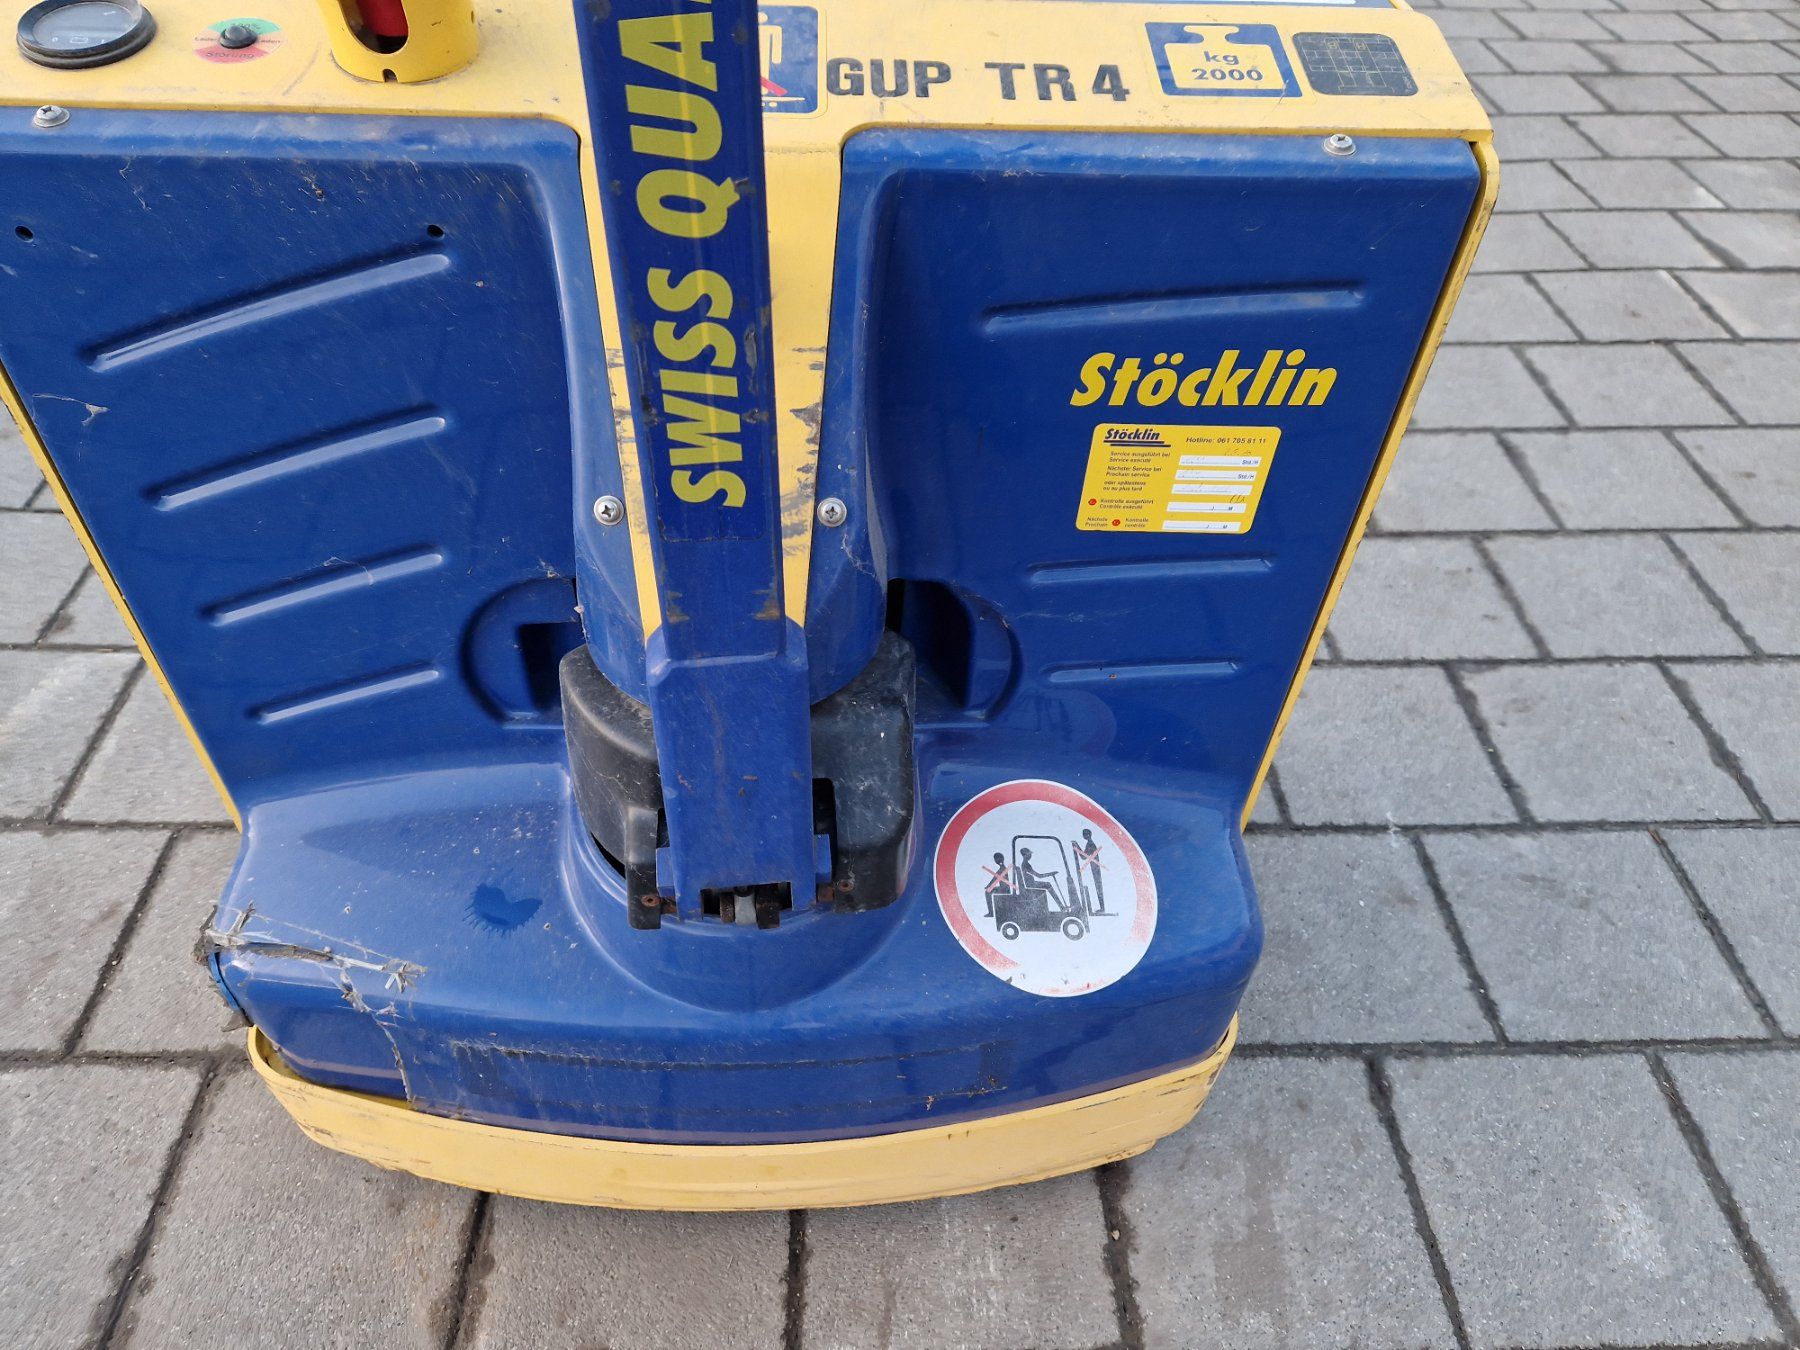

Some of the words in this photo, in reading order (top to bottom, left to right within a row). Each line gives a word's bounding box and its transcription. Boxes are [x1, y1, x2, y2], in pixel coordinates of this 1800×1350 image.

[1192, 68, 1264, 82] 2000
[1203, 51, 1240, 64] kg
[827, 58, 952, 98] GUP
[617, 0, 741, 239] QUA
[647, 267, 747, 508] SWISS
[1069, 348, 1338, 407] Stöcklin
[1104, 428, 1160, 440] Stöcklin
